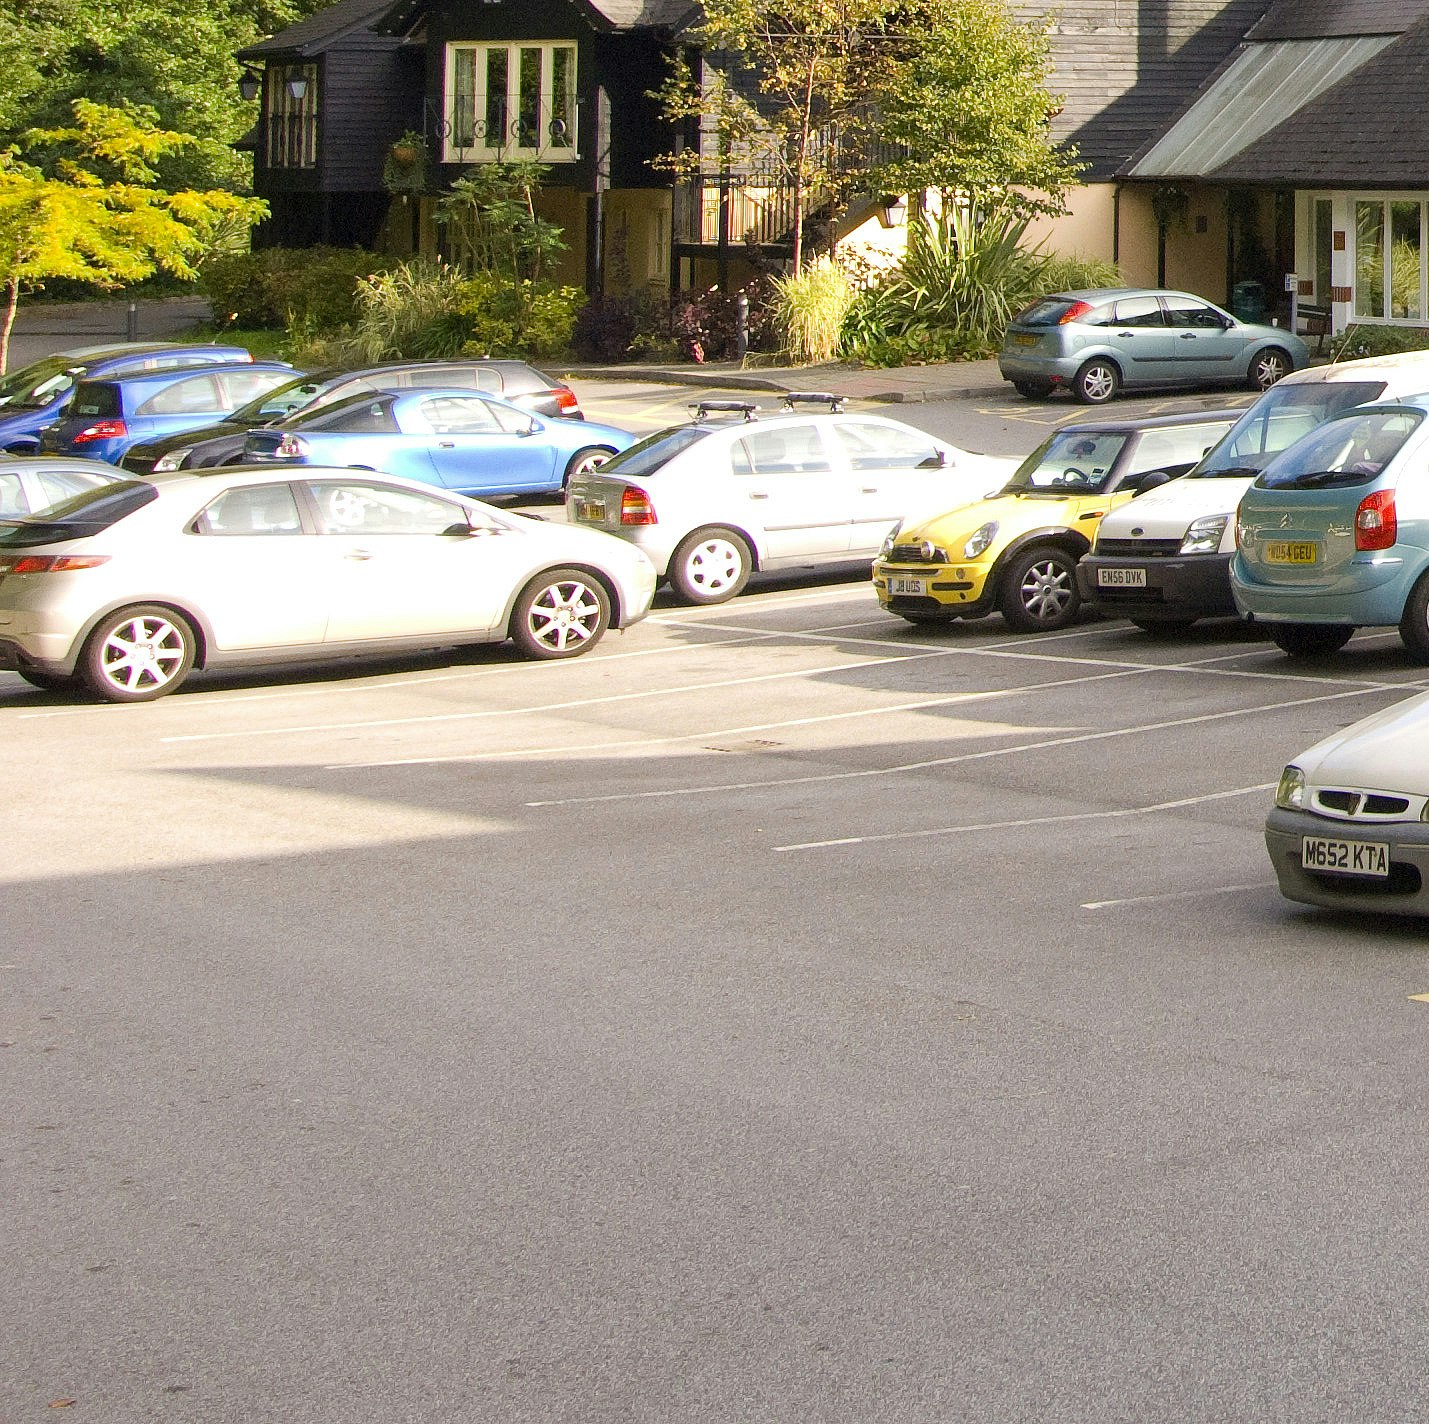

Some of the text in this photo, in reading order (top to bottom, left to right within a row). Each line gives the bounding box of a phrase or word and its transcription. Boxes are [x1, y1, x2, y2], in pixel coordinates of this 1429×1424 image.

[1101, 570, 1143, 584] EN56 DVK
[1305, 840, 1387, 872] M652 KTA
